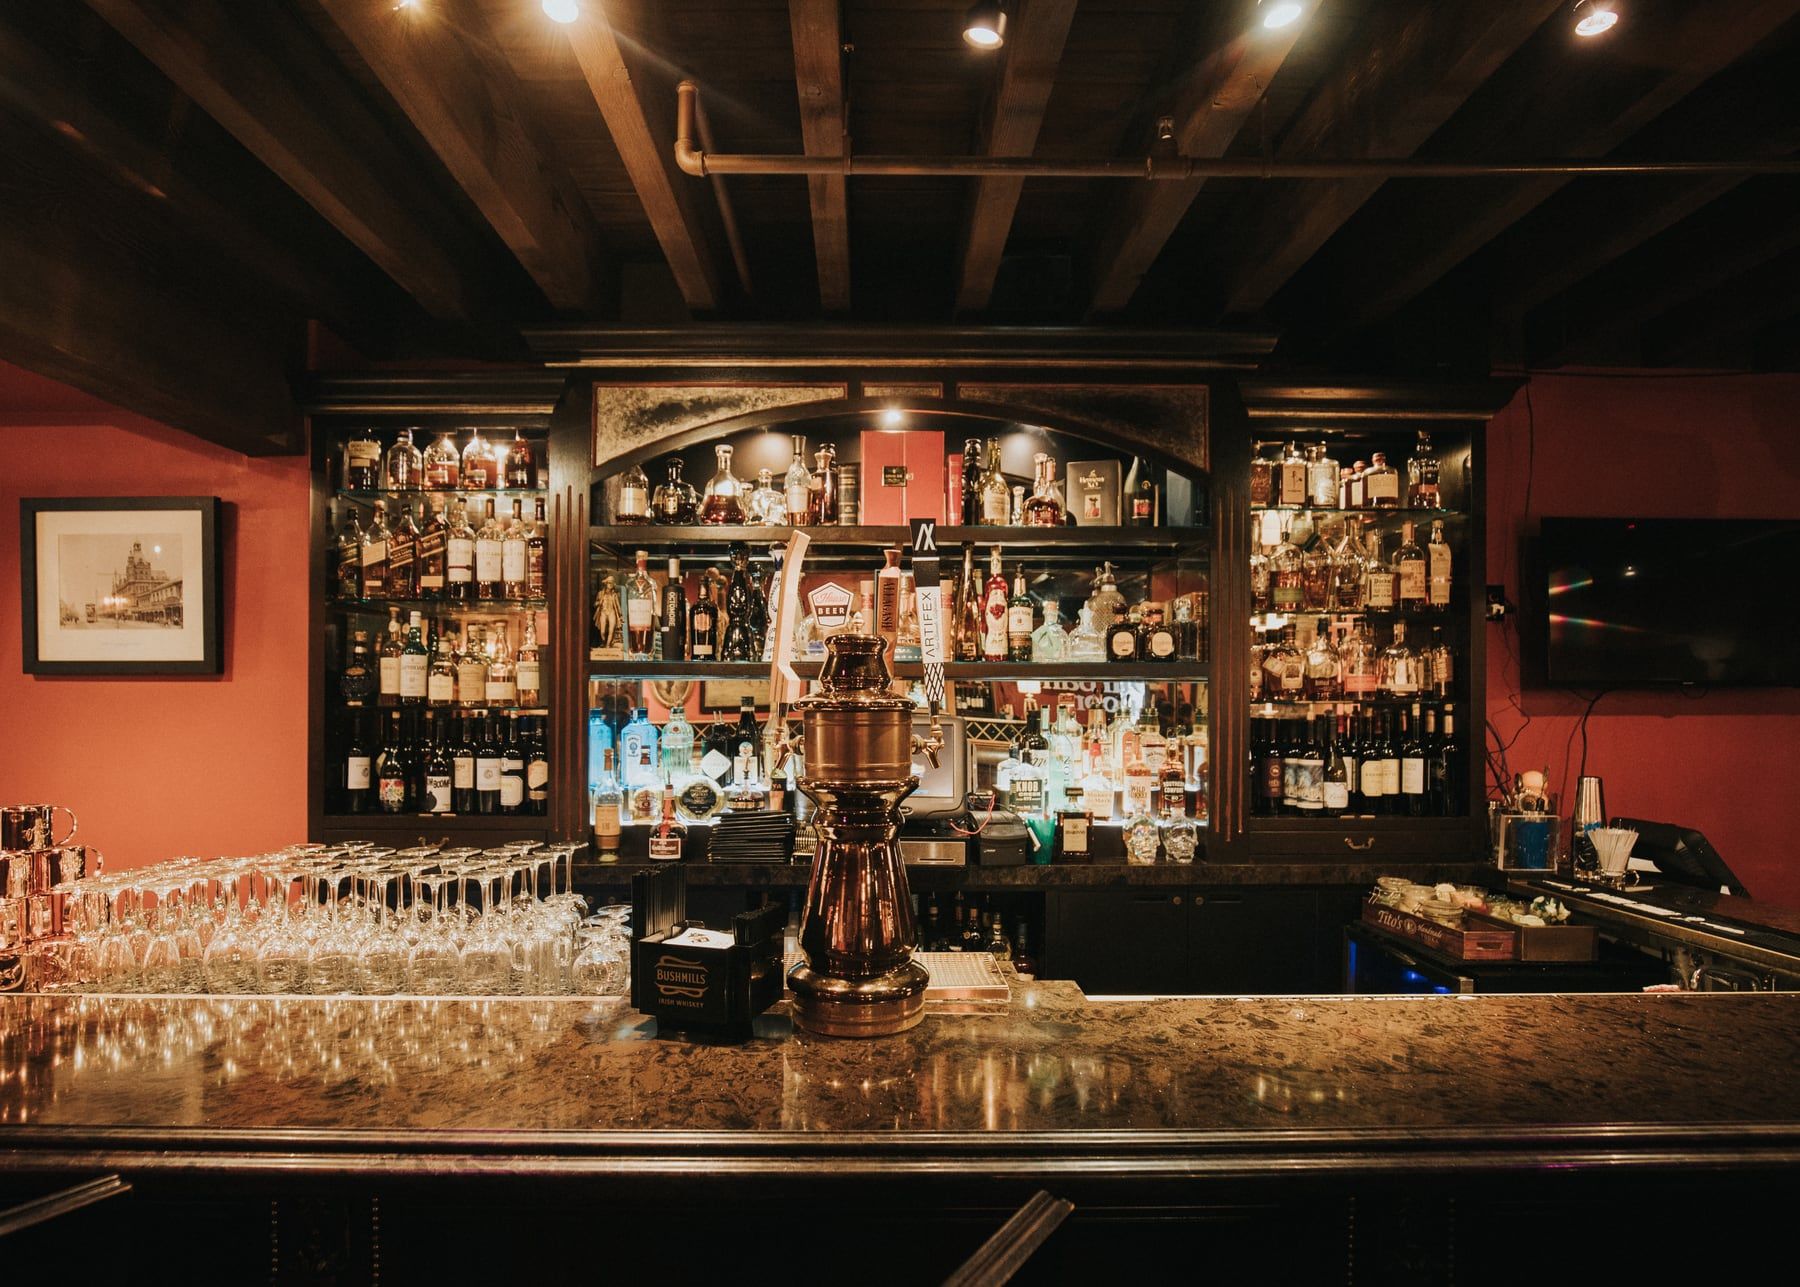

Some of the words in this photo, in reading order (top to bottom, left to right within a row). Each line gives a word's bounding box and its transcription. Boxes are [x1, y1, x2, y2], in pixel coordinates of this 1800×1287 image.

[817, 607, 845, 615] BEER
[882, 582, 895, 630] ALLAGASH
[921, 591, 936, 658] ARTIFEX
[1016, 781, 1039, 792] KNOB
[1378, 910, 1402, 930] Tito's
[657, 969, 706, 984] BUSHMILLS
[658, 997, 675, 1006] IRISH
[676, 999, 705, 1008] WHISKEY
